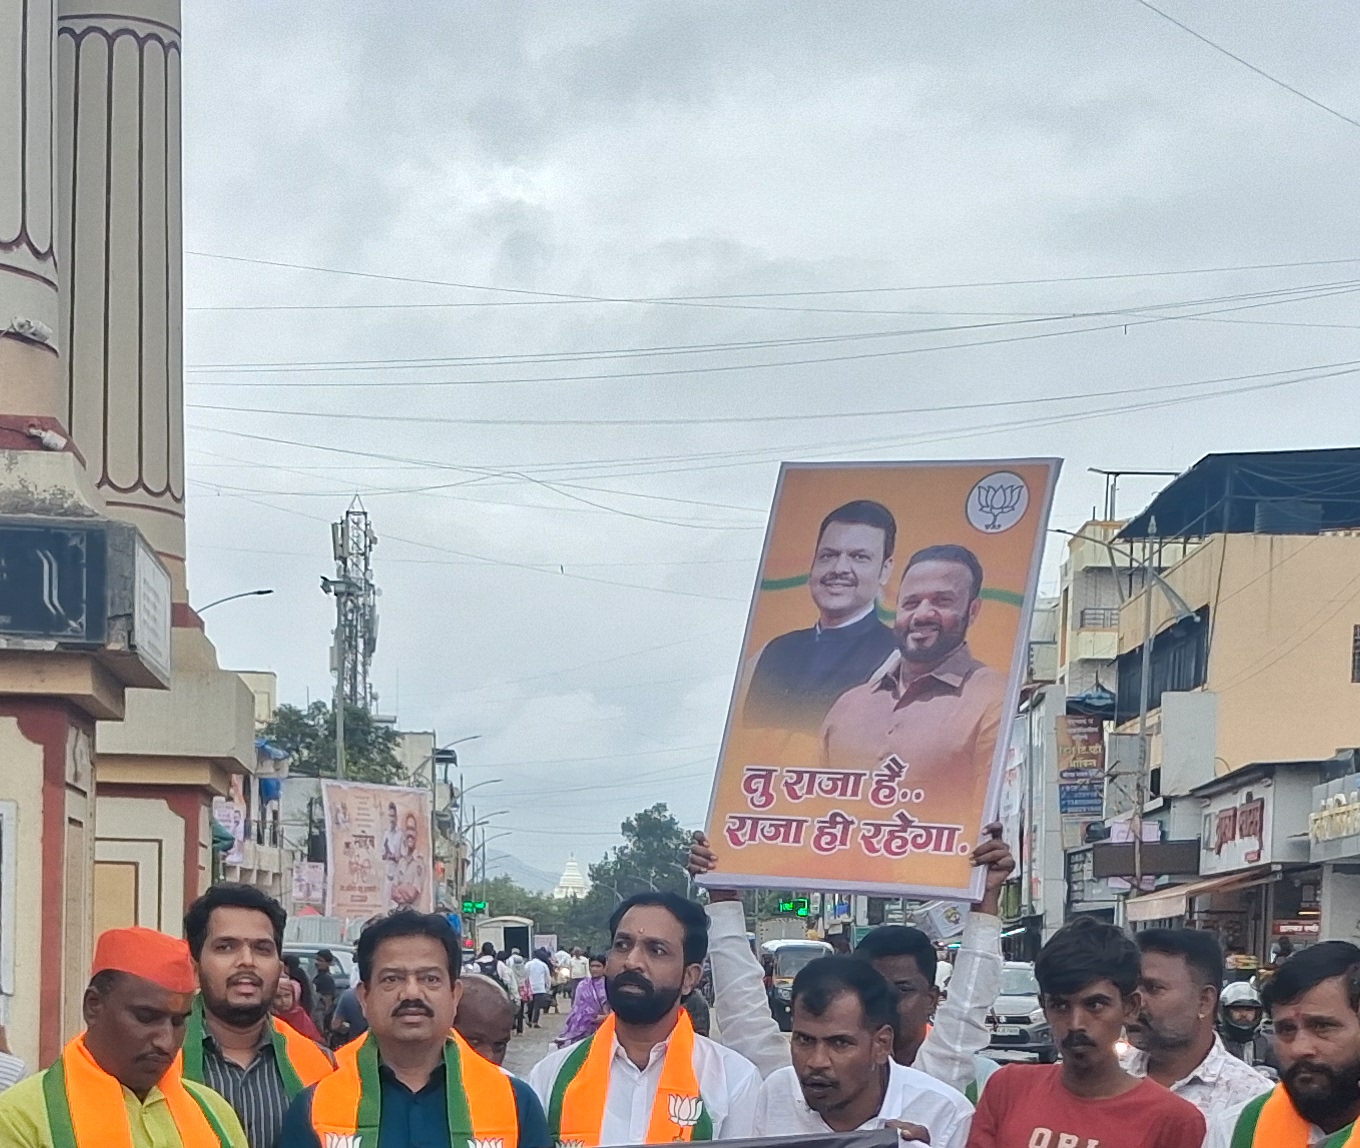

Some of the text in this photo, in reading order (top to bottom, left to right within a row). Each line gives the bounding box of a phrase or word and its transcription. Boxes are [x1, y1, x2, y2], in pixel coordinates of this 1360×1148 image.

[742, 767, 778, 810] तु
[781, 768, 867, 803] राजा
[725, 810, 971, 859] राजा ही रहेगा.
